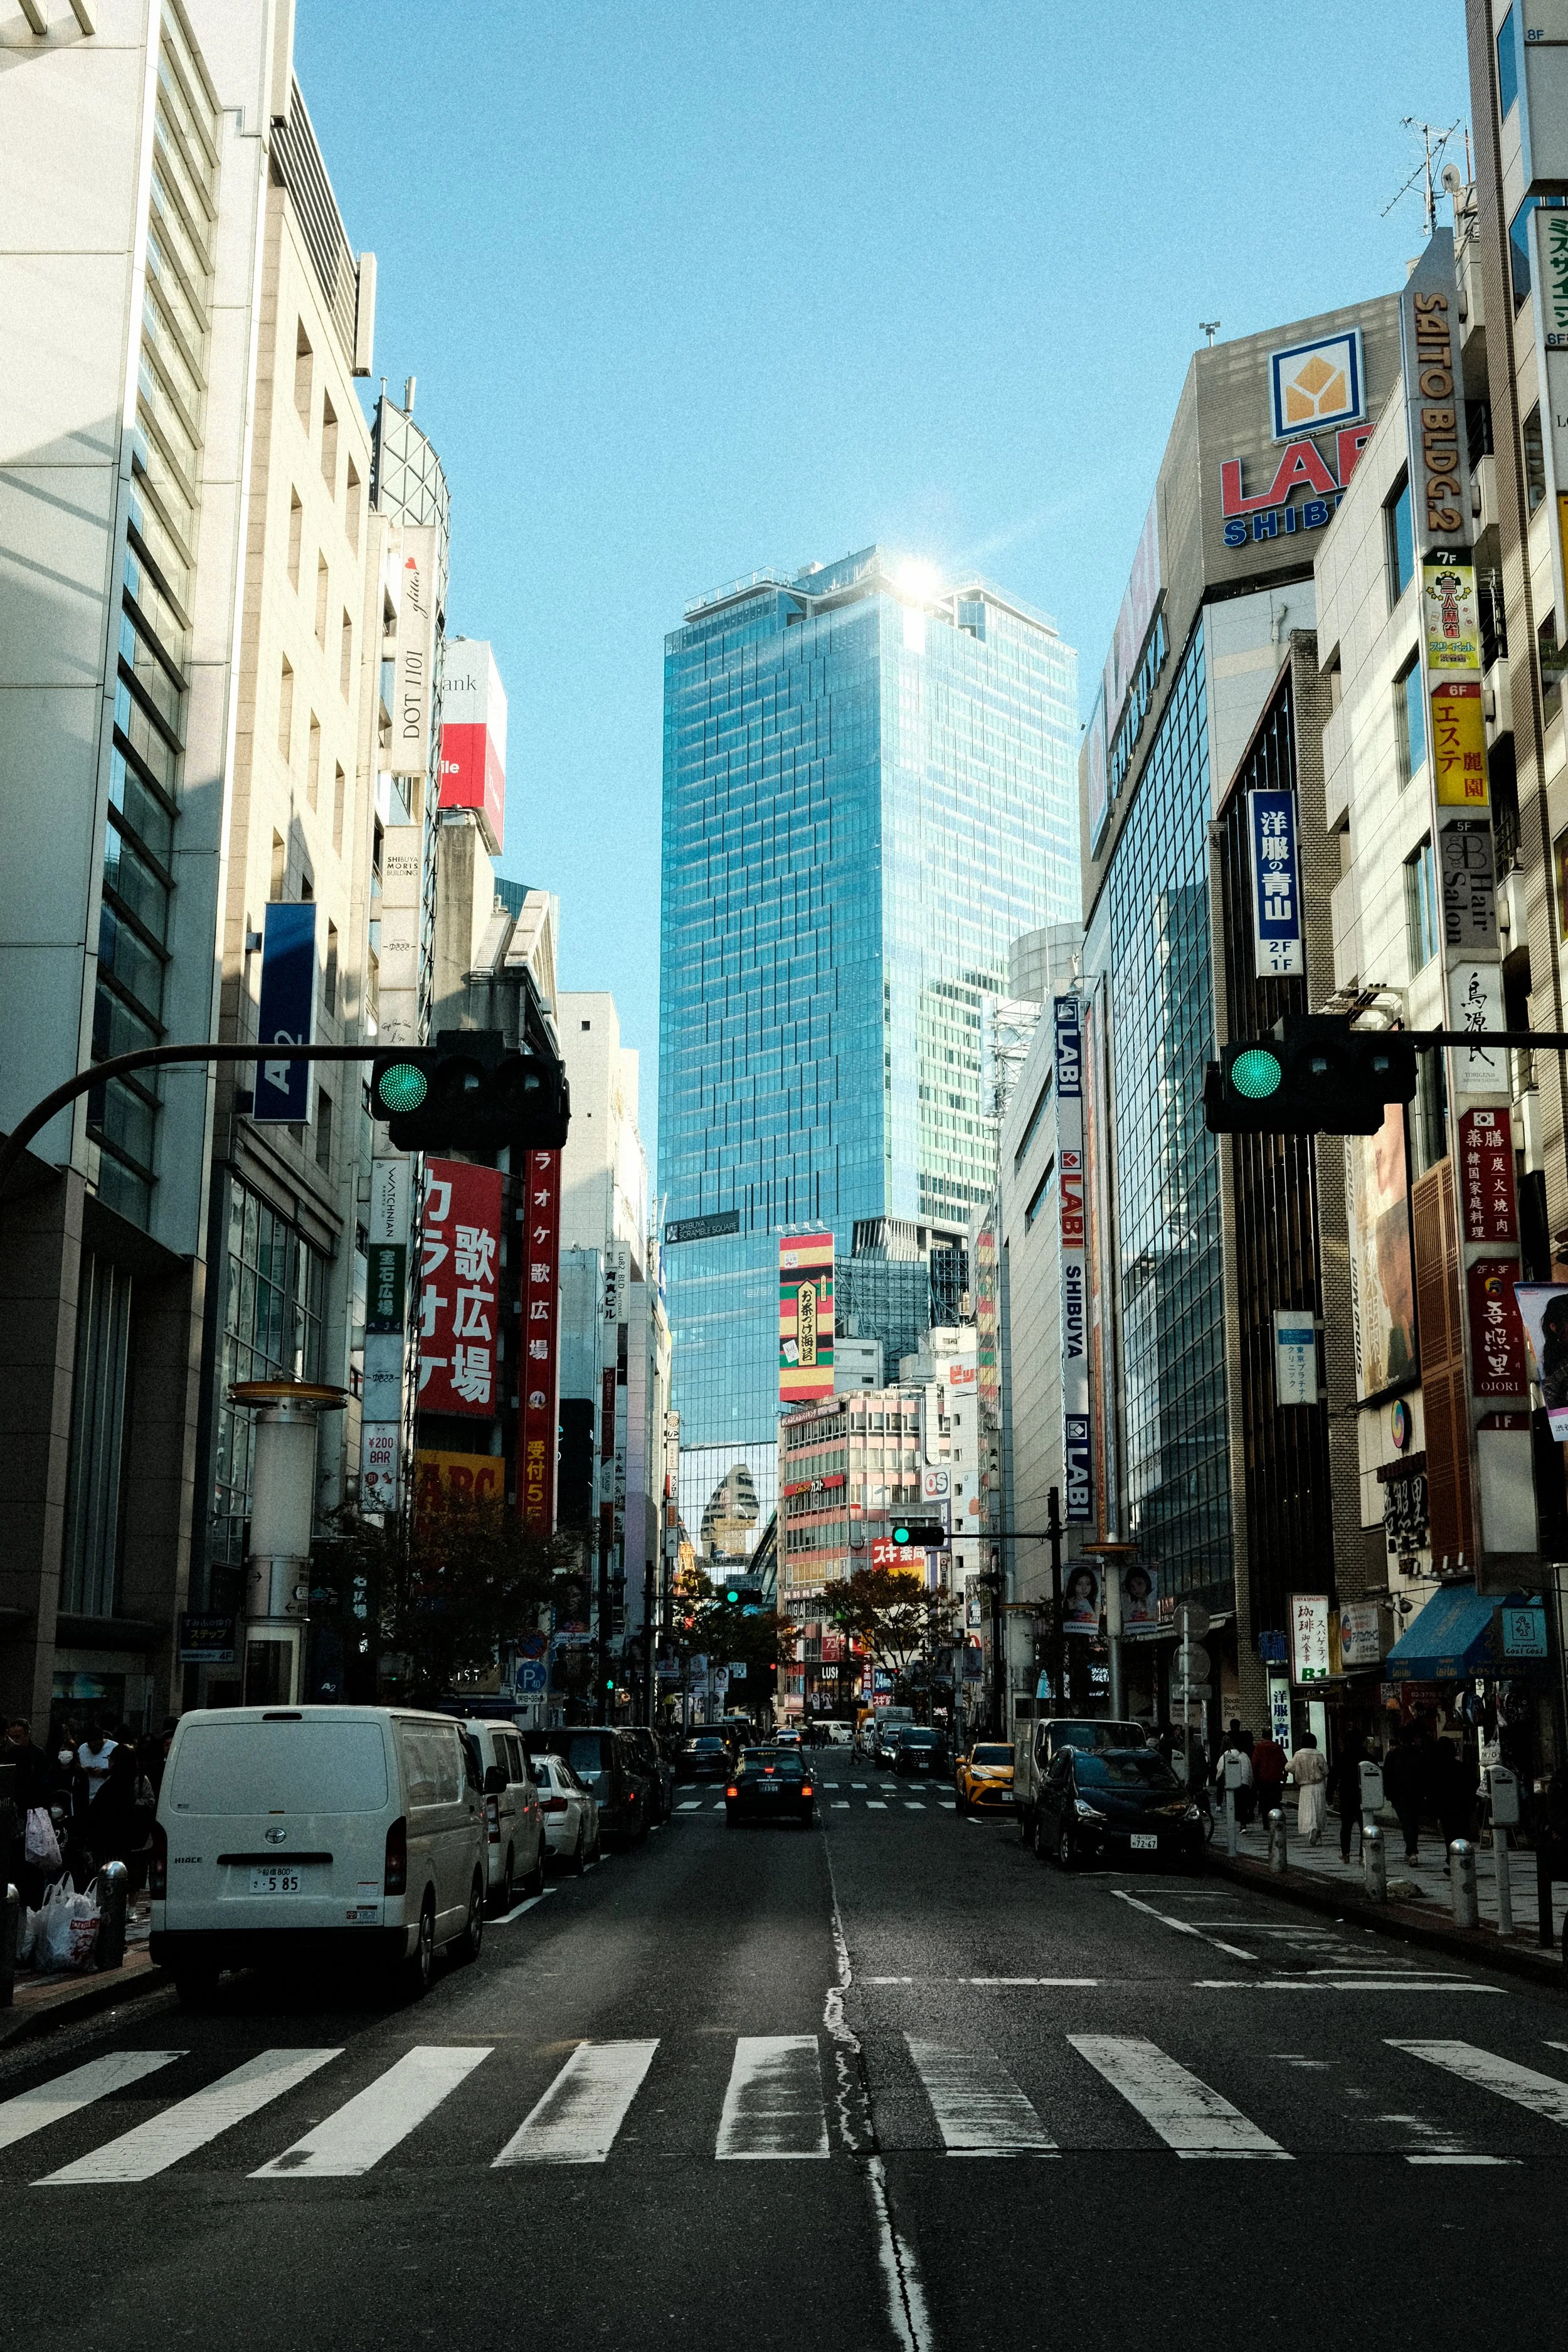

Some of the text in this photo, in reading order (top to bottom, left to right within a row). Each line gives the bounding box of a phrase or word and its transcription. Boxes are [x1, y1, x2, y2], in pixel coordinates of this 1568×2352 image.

[1527, 29, 1544, 40] 8F
[1414, 292, 1454, 400] SAITO
[1223, 493, 1344, 546] SHIB
[1436, 551, 1456, 564] 7F
[1440, 579, 1459, 638] 三人麻雀
[1449, 685, 1467, 696] 6F
[1435, 706, 1461, 774] エステ
[1463, 752, 1484, 798] 麗園
[1457, 822, 1472, 832] 5F
[1260, 810, 1292, 921] 洋服の青山
[1444, 871, 1468, 944] Salon
[1470, 874, 1495, 931] Hair
[1269, 941, 1292, 953] 2F
[1271, 958, 1293, 971] 1F
[1057, 1029, 1081, 1093] LABI
[1465, 1128, 1505, 1148] 薬膳
[386, 1167, 396, 1237] WATCHNIAN
[1466, 1152, 1486, 1238] 韓国家庭料理
[1491, 1157, 1508, 1232] 炭火焼肉
[1060, 1173, 1084, 1249] LABI
[679, 1221, 706, 1231] SHIBUYA
[679, 1222, 737, 1239] SCRAMBLE SQUARE
[376, 1249, 395, 1316] 宝石広場
[450, 1224, 497, 1404] 歌広場
[1065, 1264, 1083, 1359] SHIBUYA
[800, 1290, 814, 1362] お茶づけ海苔
[1482, 1301, 1510, 1377] 吾照里
[1296, 1347, 1307, 1404] 東京プラチナム
[1481, 1381, 1518, 1391] OJORI
[1495, 1414, 1513, 1428] 1F
[368, 1437, 393, 1448] ¥200
[370, 1451, 390, 1463] BAR
[810, 1479, 824, 1492] ガスト
[925, 1471, 948, 1496] OS
[1067, 1447, 1089, 1517] LABI
[874, 1545, 925, 1564] スギ薬局
[183, 1618, 233, 1628] すみふの仲介
[1298, 1605, 1315, 1633] 珈琲
[190, 1629, 228, 1640] ステップ
[1316, 1619, 1327, 1664] スパゲティ
[219, 1651, 232, 1660] 4F
[1301, 1634, 1311, 1664] 御食事
[320, 1682, 337, 1692] A2
[523, 1668, 536, 1688] P
[1301, 1667, 1327, 1682] B1
[1273, 1690, 1290, 1750] 洋服の青山
[1136, 1840, 1156, 1848] 72-67
[277, 1868, 291, 1876] 800
